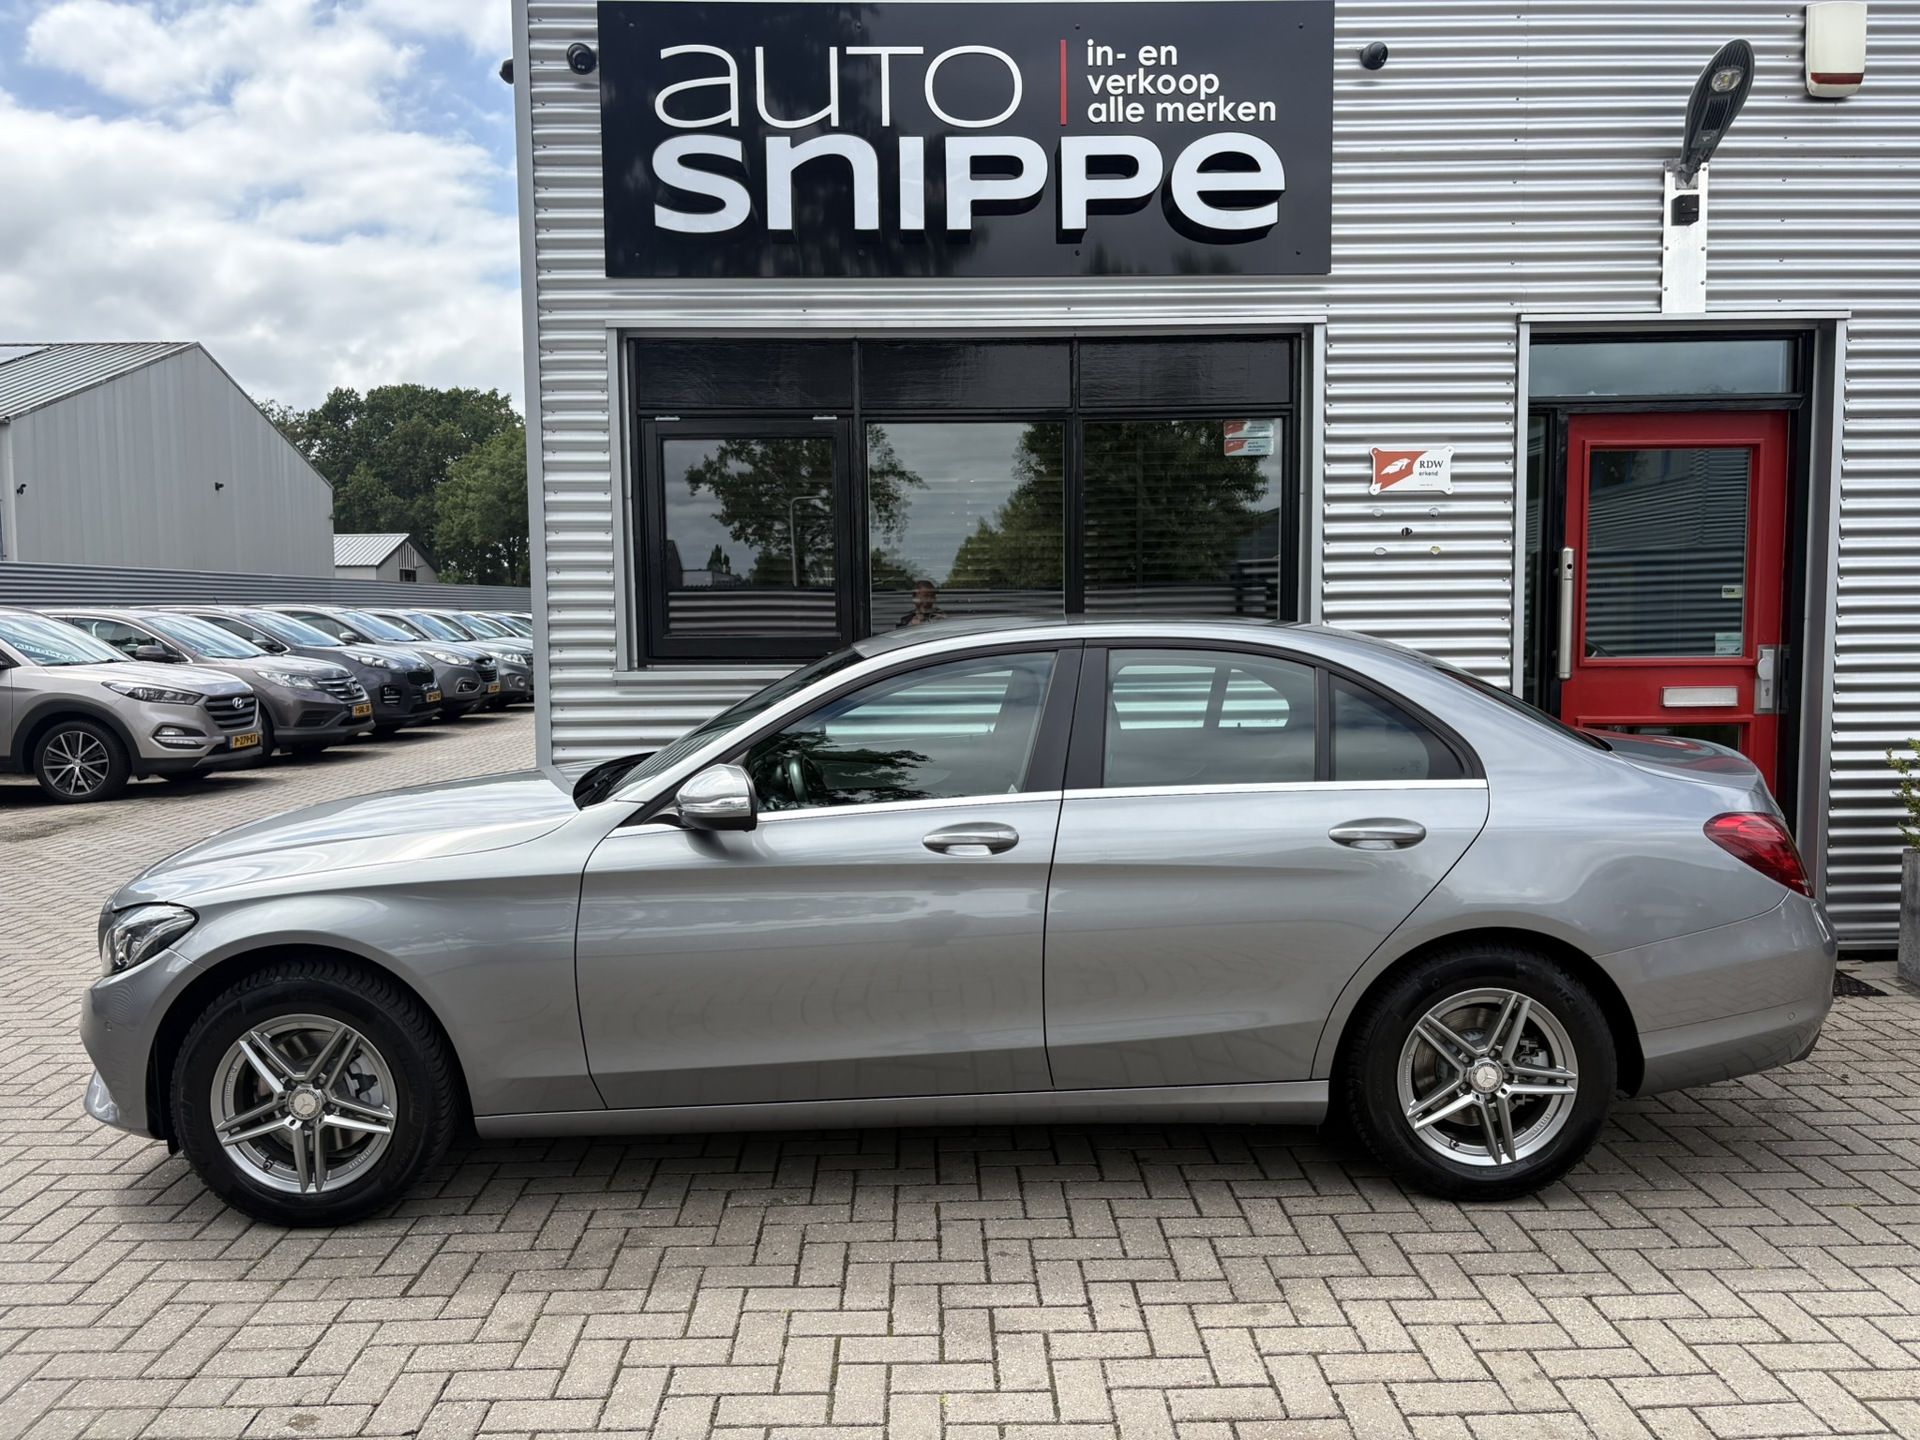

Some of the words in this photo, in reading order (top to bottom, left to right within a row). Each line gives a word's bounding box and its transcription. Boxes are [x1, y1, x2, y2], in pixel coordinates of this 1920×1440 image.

[1087, 38, 1127, 67] in-
[1138, 45, 1178, 67] en
[1086, 67, 1220, 101] verkoop
[1087, 95, 1145, 123] alle
[1156, 95, 1277, 123] merken
[1418, 460, 1444, 469] RDW
